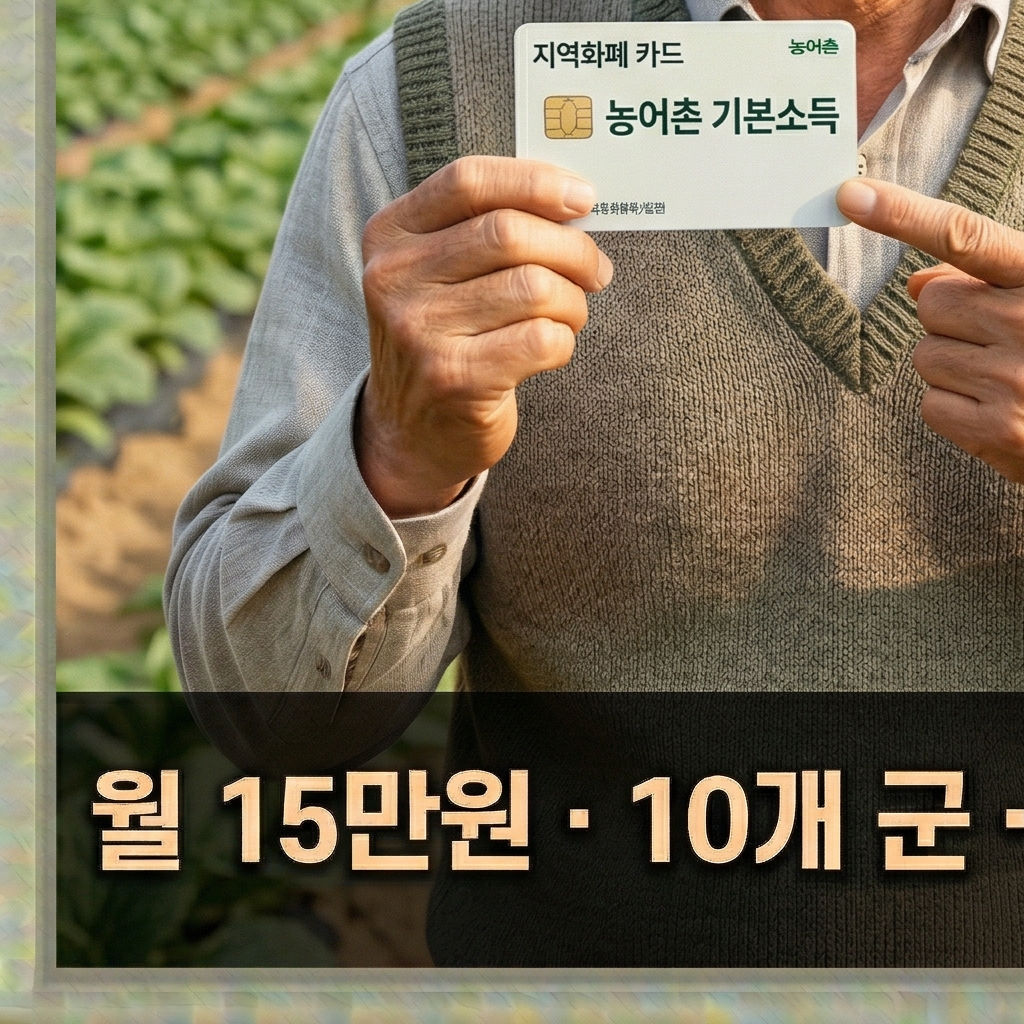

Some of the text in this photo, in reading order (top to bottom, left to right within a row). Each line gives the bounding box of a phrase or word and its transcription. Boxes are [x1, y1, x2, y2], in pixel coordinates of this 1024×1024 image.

[532, 40, 685, 69] 지역화폐 카드
[605, 96, 840, 136] 농어촌 기본소득
